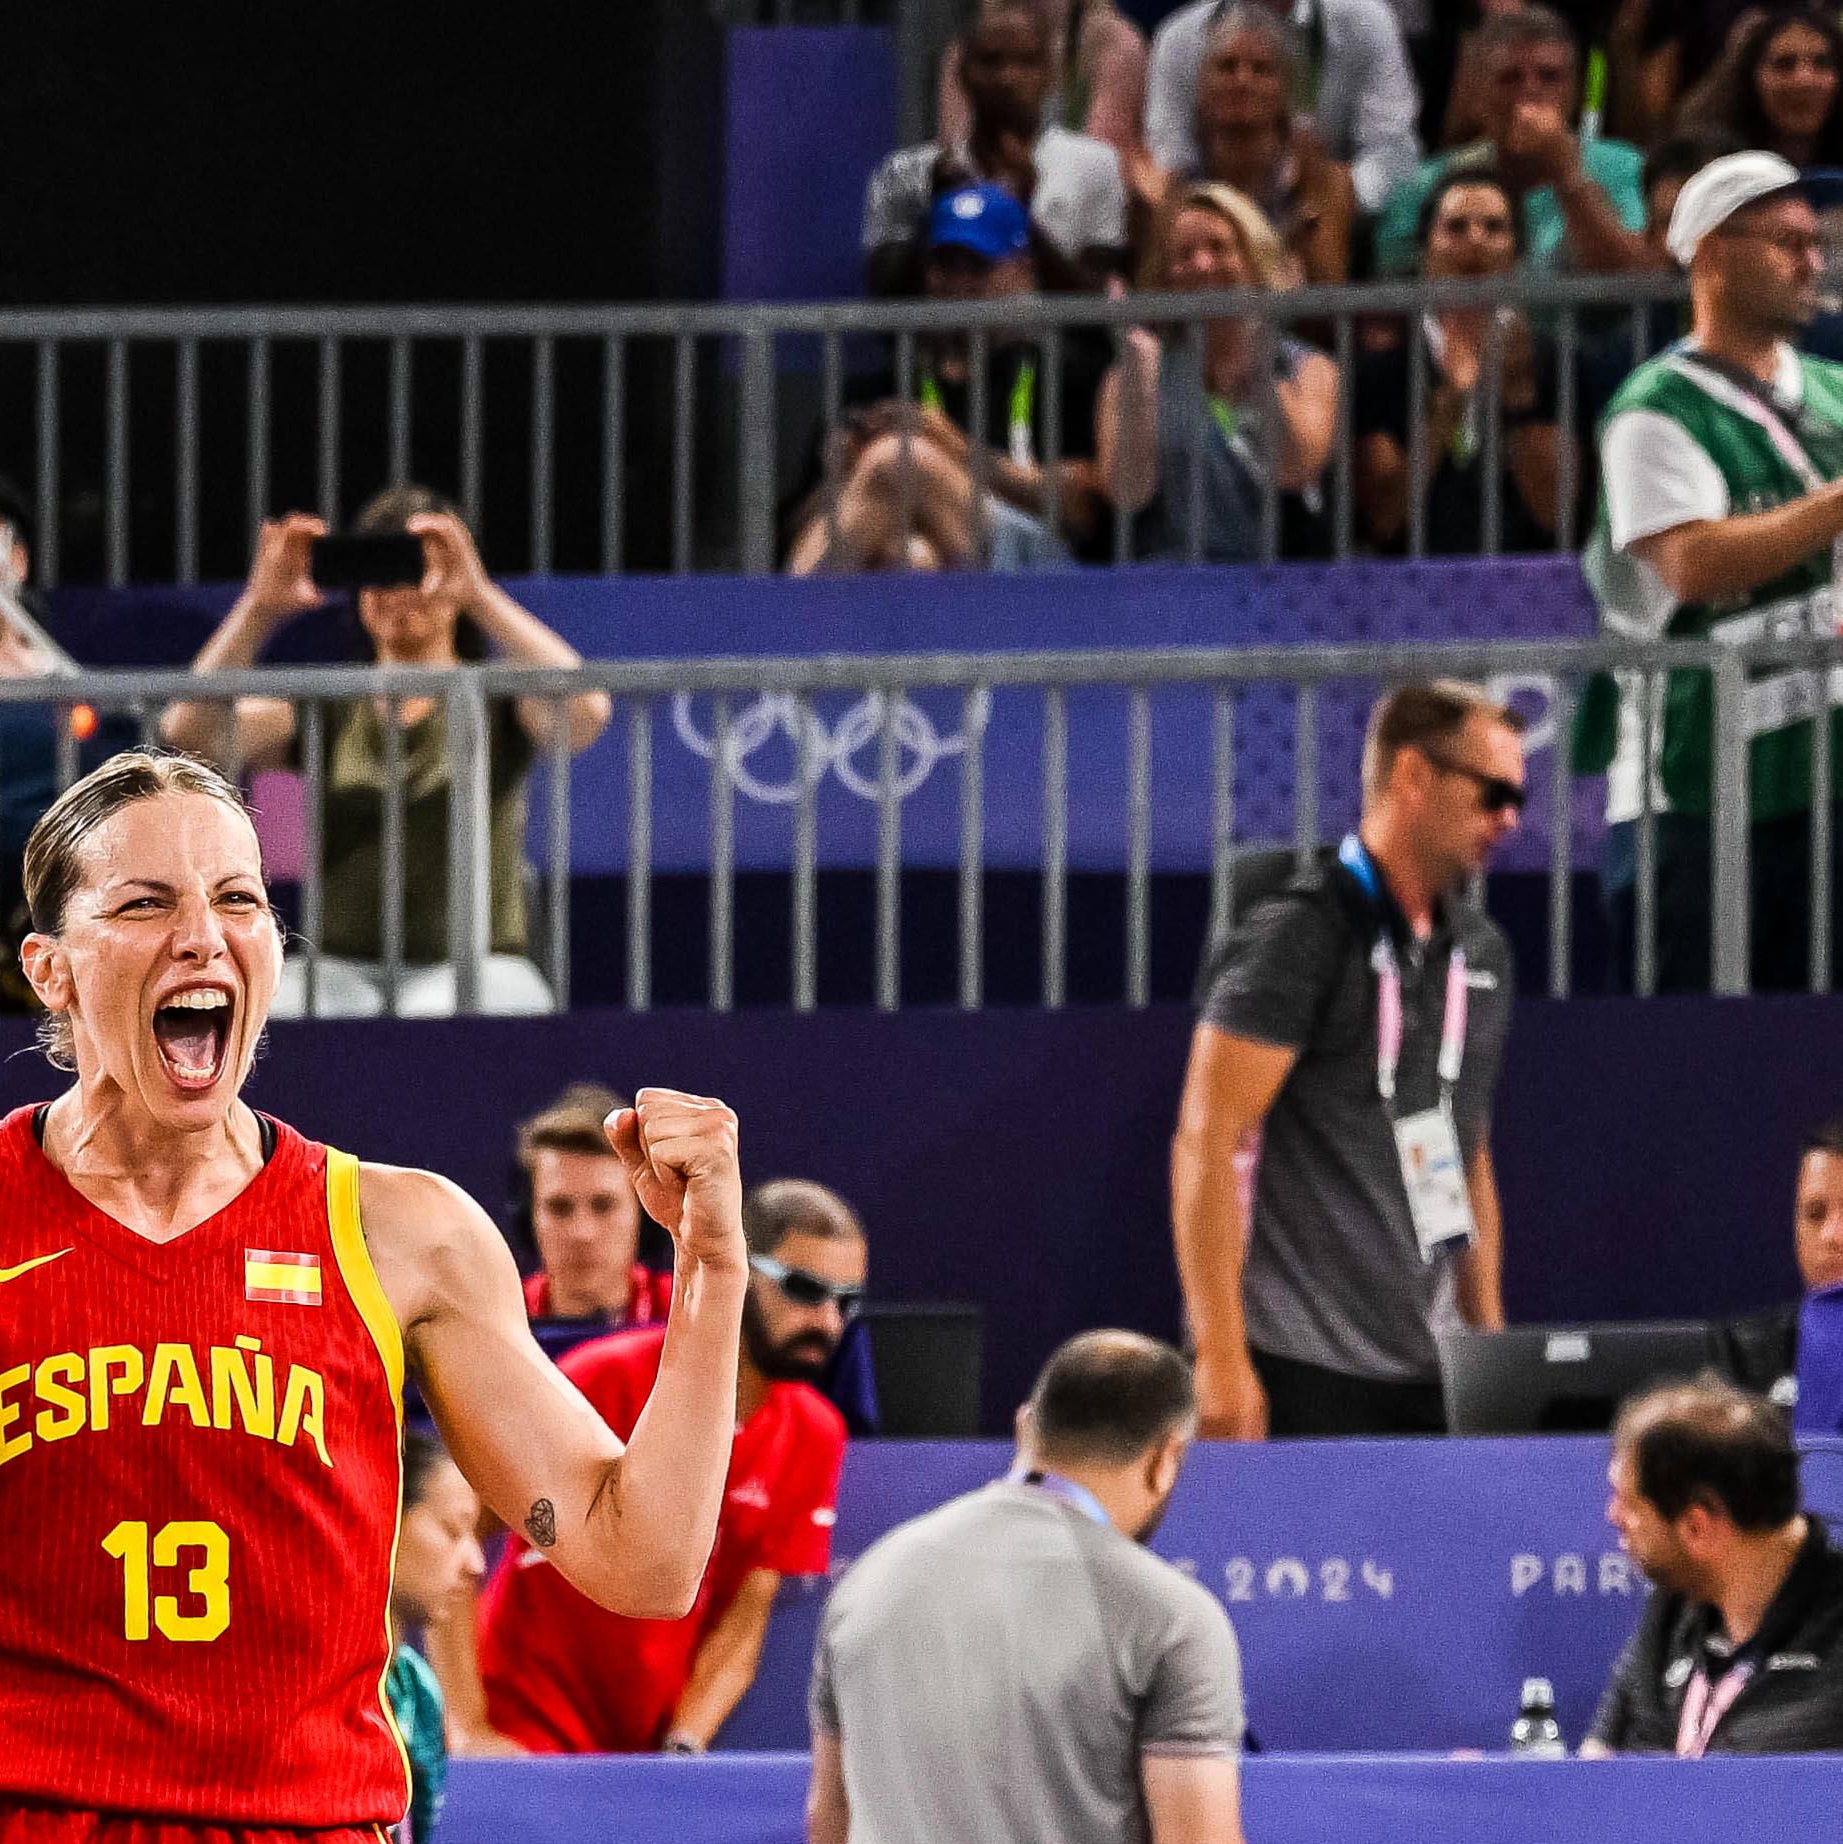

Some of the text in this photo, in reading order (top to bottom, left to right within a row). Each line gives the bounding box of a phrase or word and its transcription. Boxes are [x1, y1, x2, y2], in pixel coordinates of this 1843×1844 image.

[101, 1520, 231, 1643] 13
[1225, 1557, 1394, 1600] 2024
[1512, 1554, 1655, 1598] PAR
